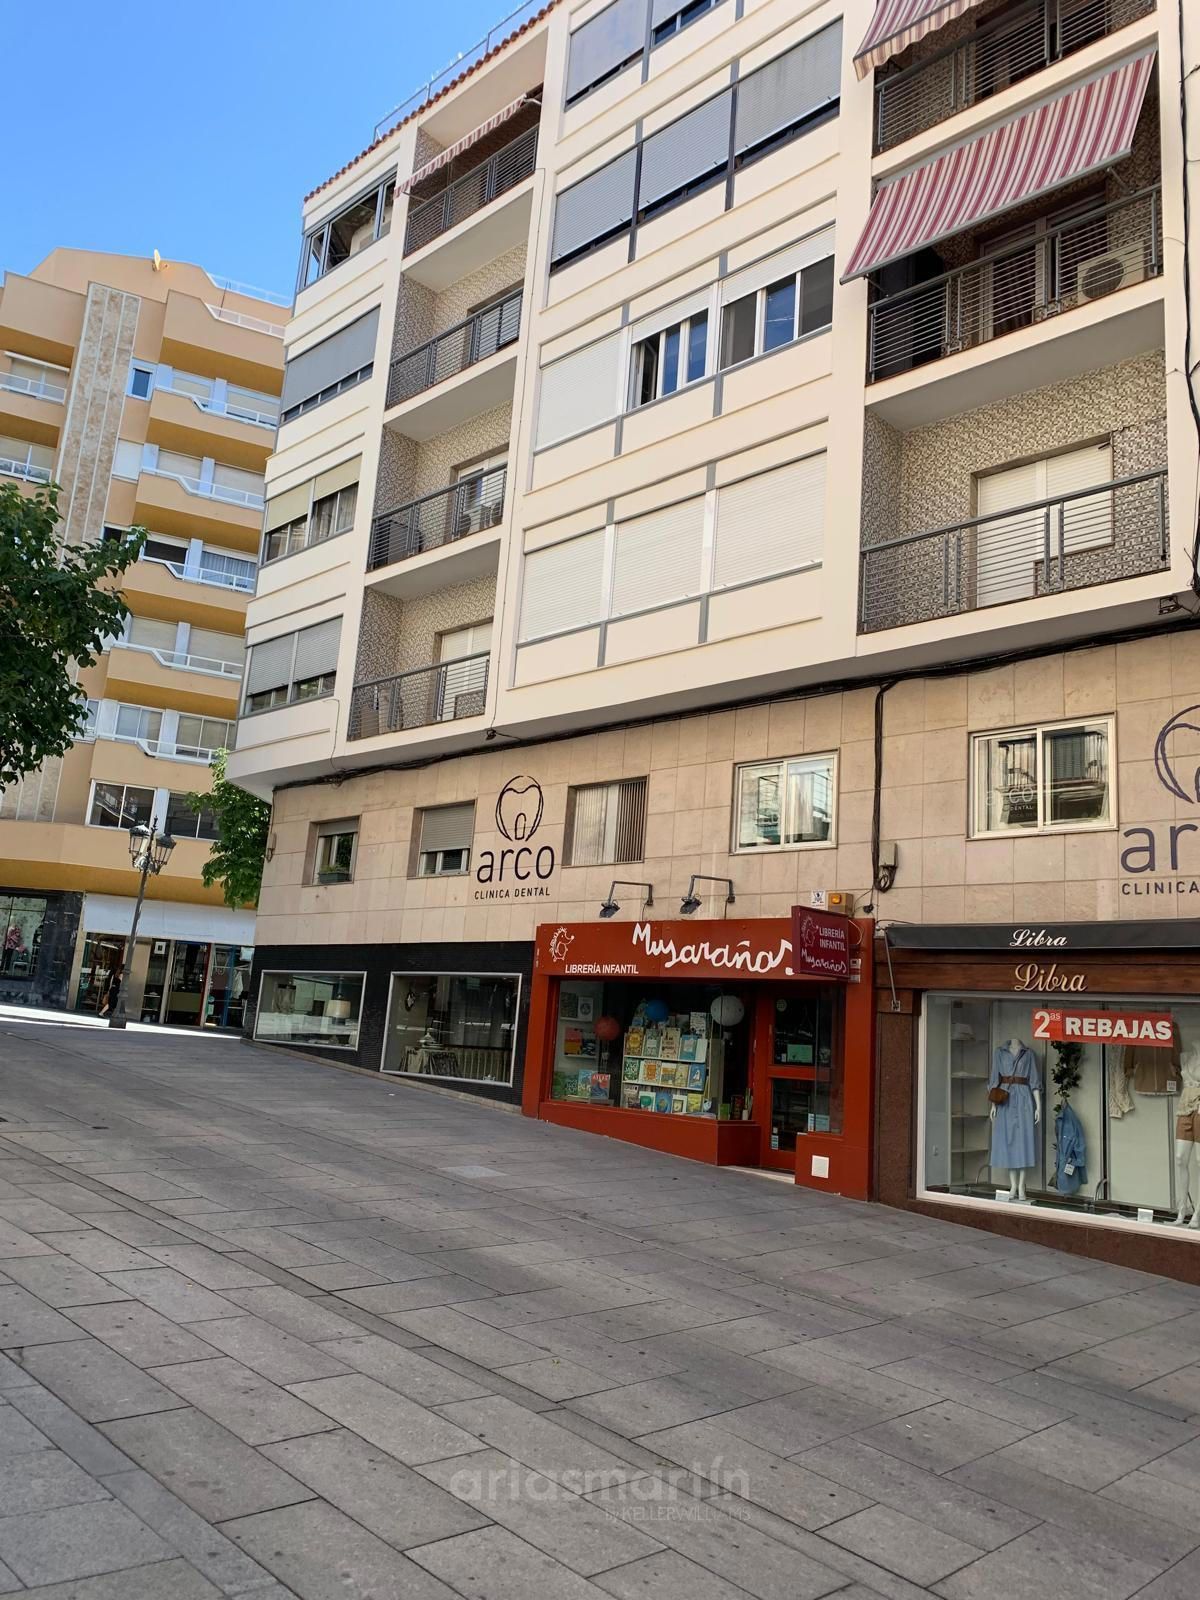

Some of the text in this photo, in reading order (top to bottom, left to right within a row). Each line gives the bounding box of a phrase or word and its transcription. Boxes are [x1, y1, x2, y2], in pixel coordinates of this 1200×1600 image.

[476, 845, 555, 884] arco
[474, 887, 551, 900] CLINICA DENTAL
[1121, 881, 1200, 896] CLINICA
[819, 926, 845, 940] LIBRERÍA
[1009, 928, 1068, 947] Libra
[819, 938, 846, 952] INFANTIL
[564, 961, 639, 975] LIBRERÍA INFANTIL
[1014, 963, 1088, 992] Libra
[1065, 1017, 1172, 1040] REBAJAS
